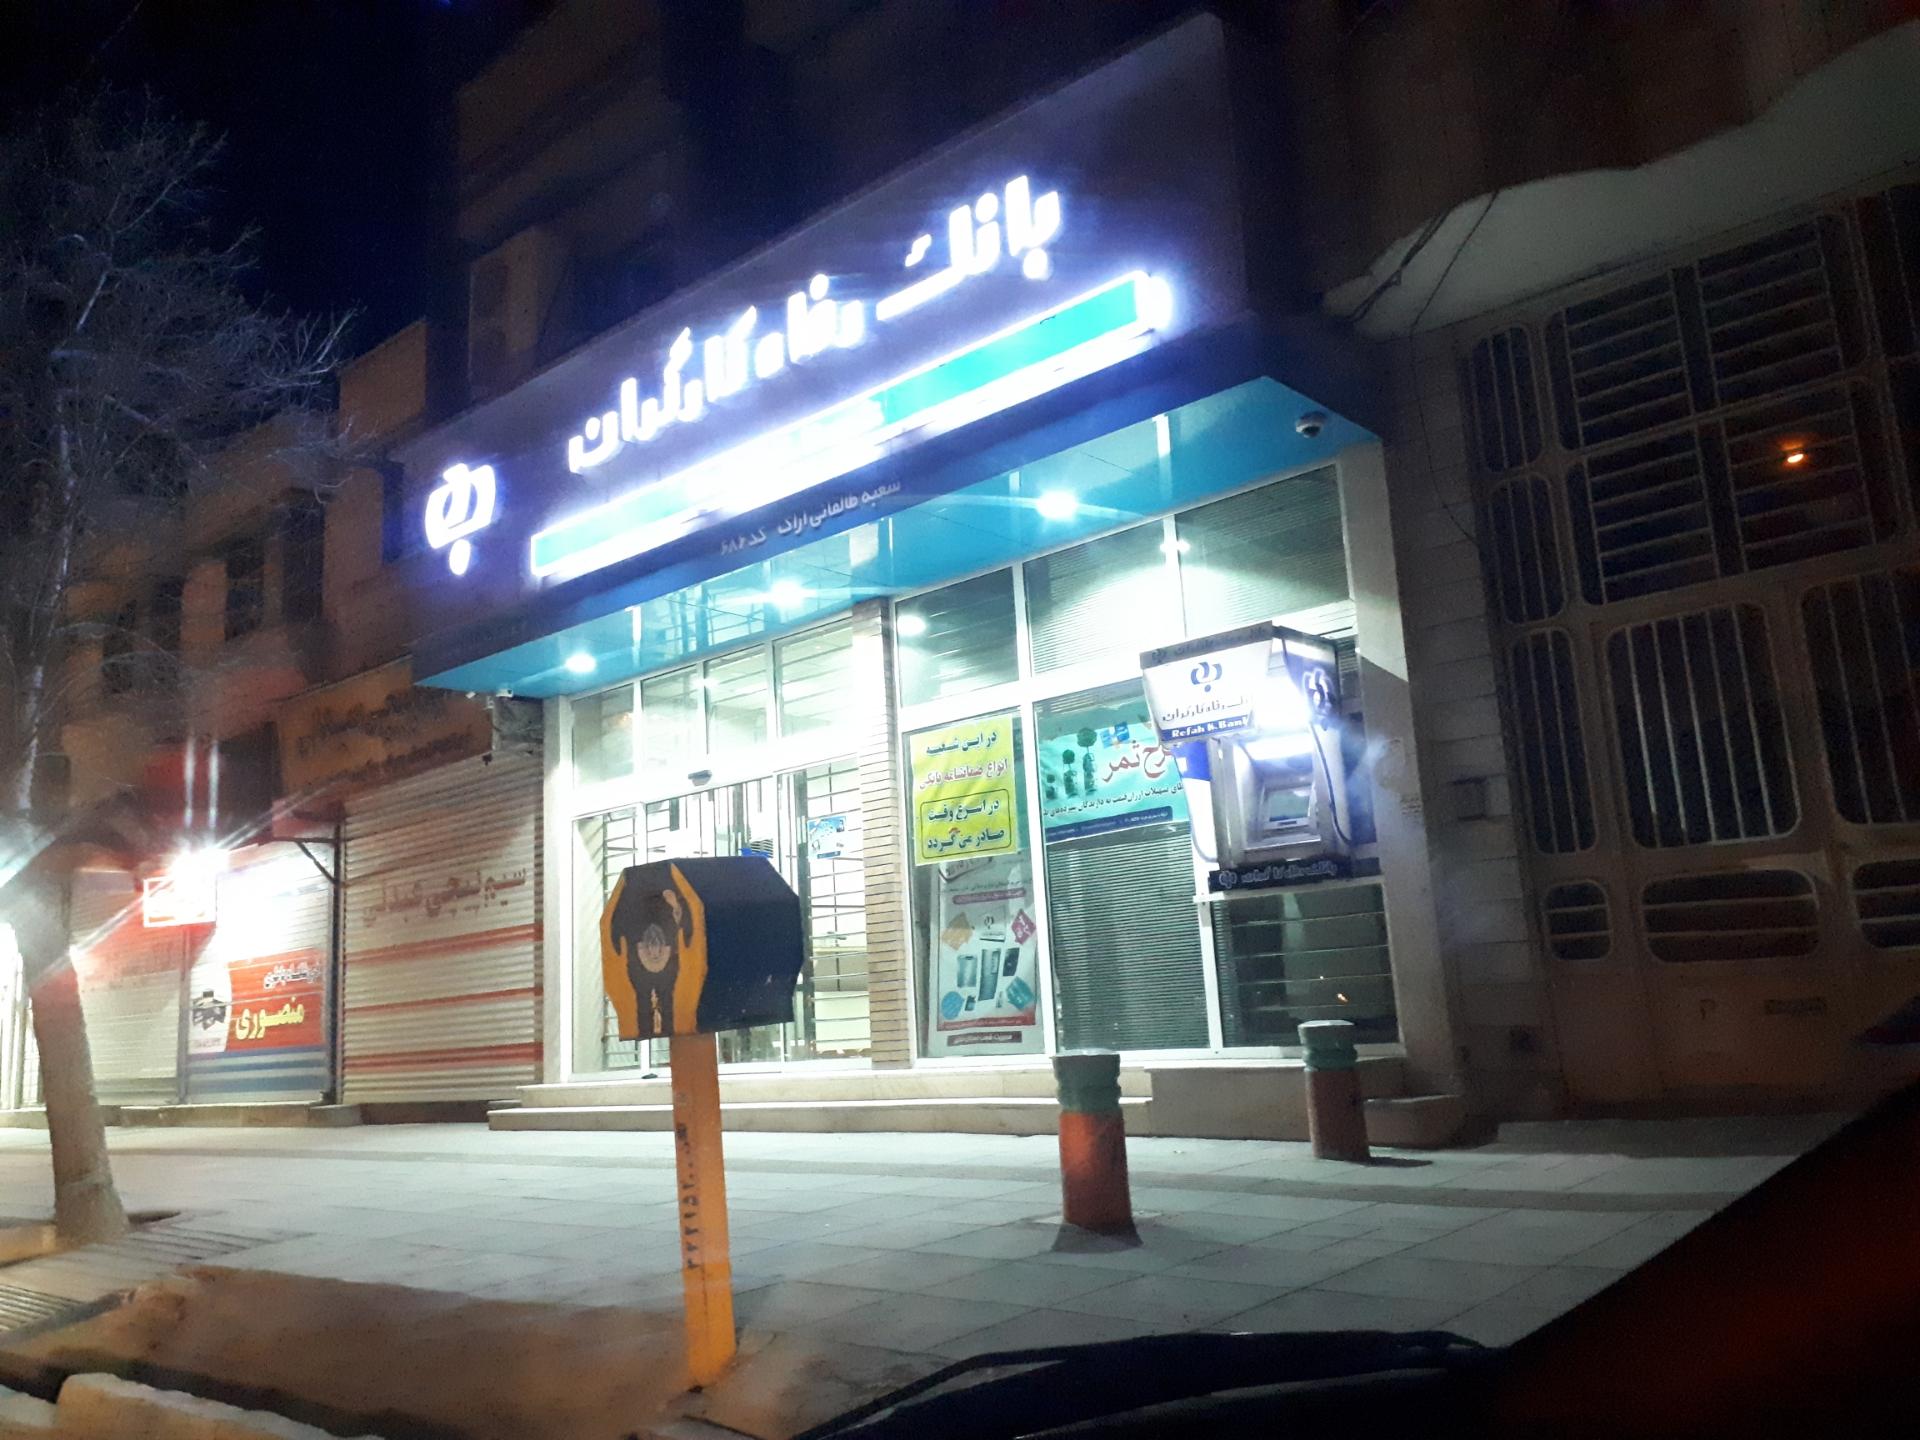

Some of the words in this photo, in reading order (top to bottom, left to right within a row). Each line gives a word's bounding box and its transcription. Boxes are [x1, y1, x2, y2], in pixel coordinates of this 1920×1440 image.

[878, 175, 1060, 320] بانک
[755, 272, 863, 380] رفاه
[568, 306, 757, 474] کارگران
[777, 511, 808, 535] اراک
[749, 527, 767, 547] کد
[986, 731, 997, 748] در
[1172, 725, 1205, 738] Refah
[926, 737, 959, 754] شعبه
[961, 732, 984, 752] این
[986, 758, 1008, 778] انواع
[1142, 745, 1174, 779] رح
[919, 771, 942, 790] بانکی
[928, 803, 954, 822] وقت
[955, 799, 986, 821] اسرع
[987, 799, 1000, 816] در
[958, 834, 973, 849] می
[975, 828, 1005, 847] صادر
[236, 996, 305, 1040] منصوری
